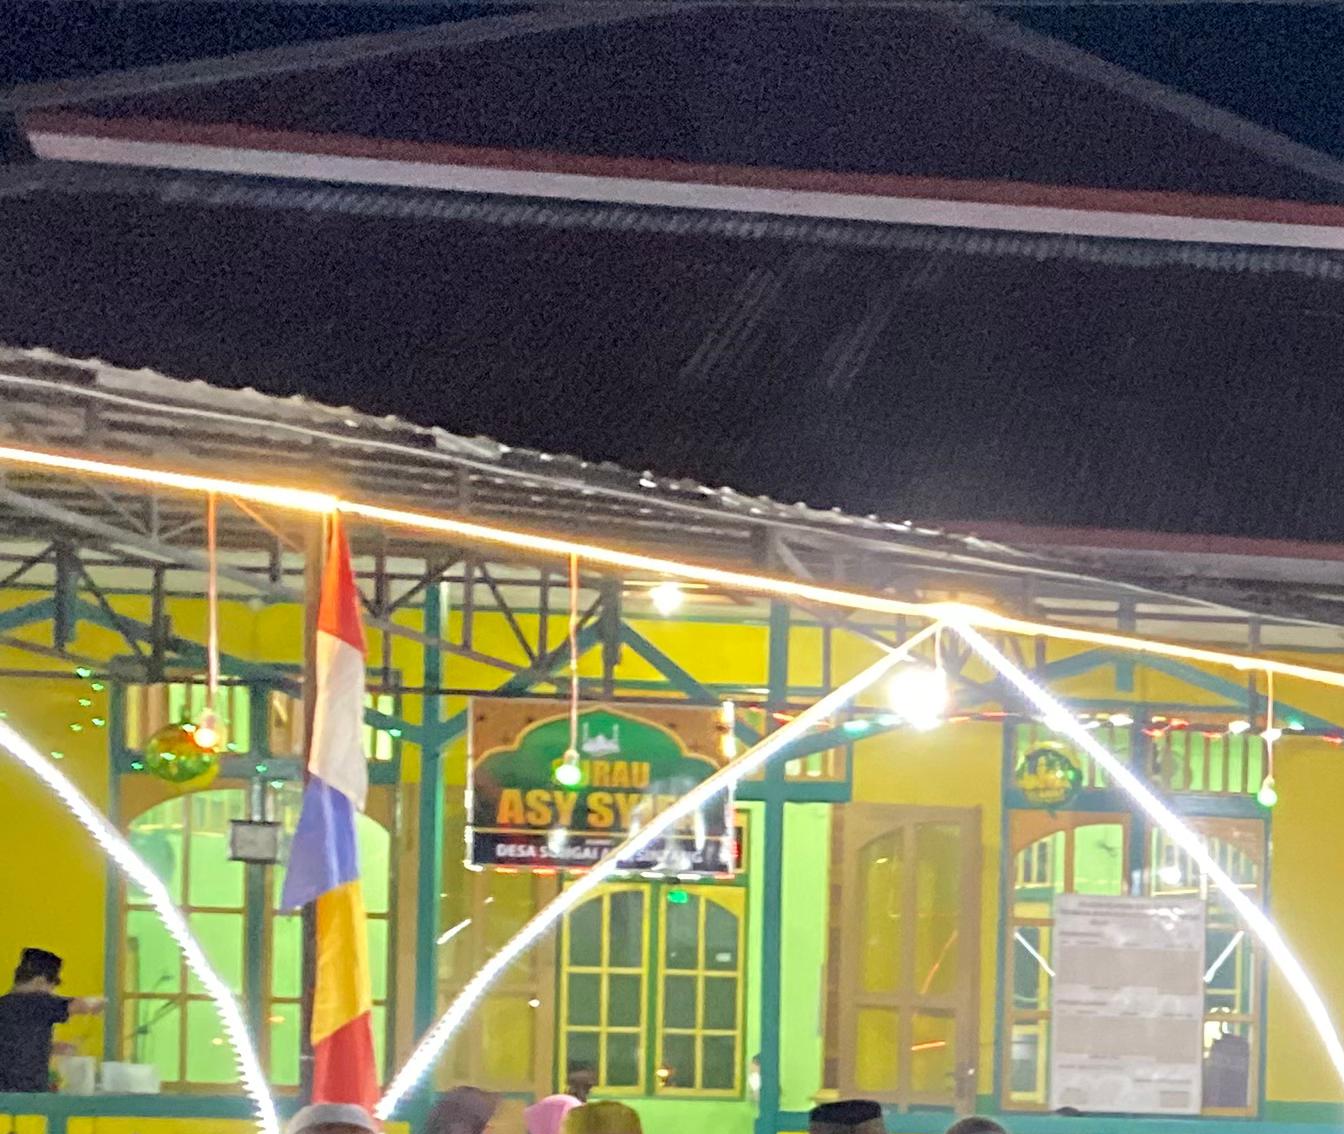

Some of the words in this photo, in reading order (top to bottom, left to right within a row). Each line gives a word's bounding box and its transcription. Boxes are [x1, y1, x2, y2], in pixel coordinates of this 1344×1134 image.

[552, 759, 651, 788] RAU
[496, 789, 576, 826] ASY
[587, 791, 700, 831] SYI
[496, 844, 536, 858] DESA
